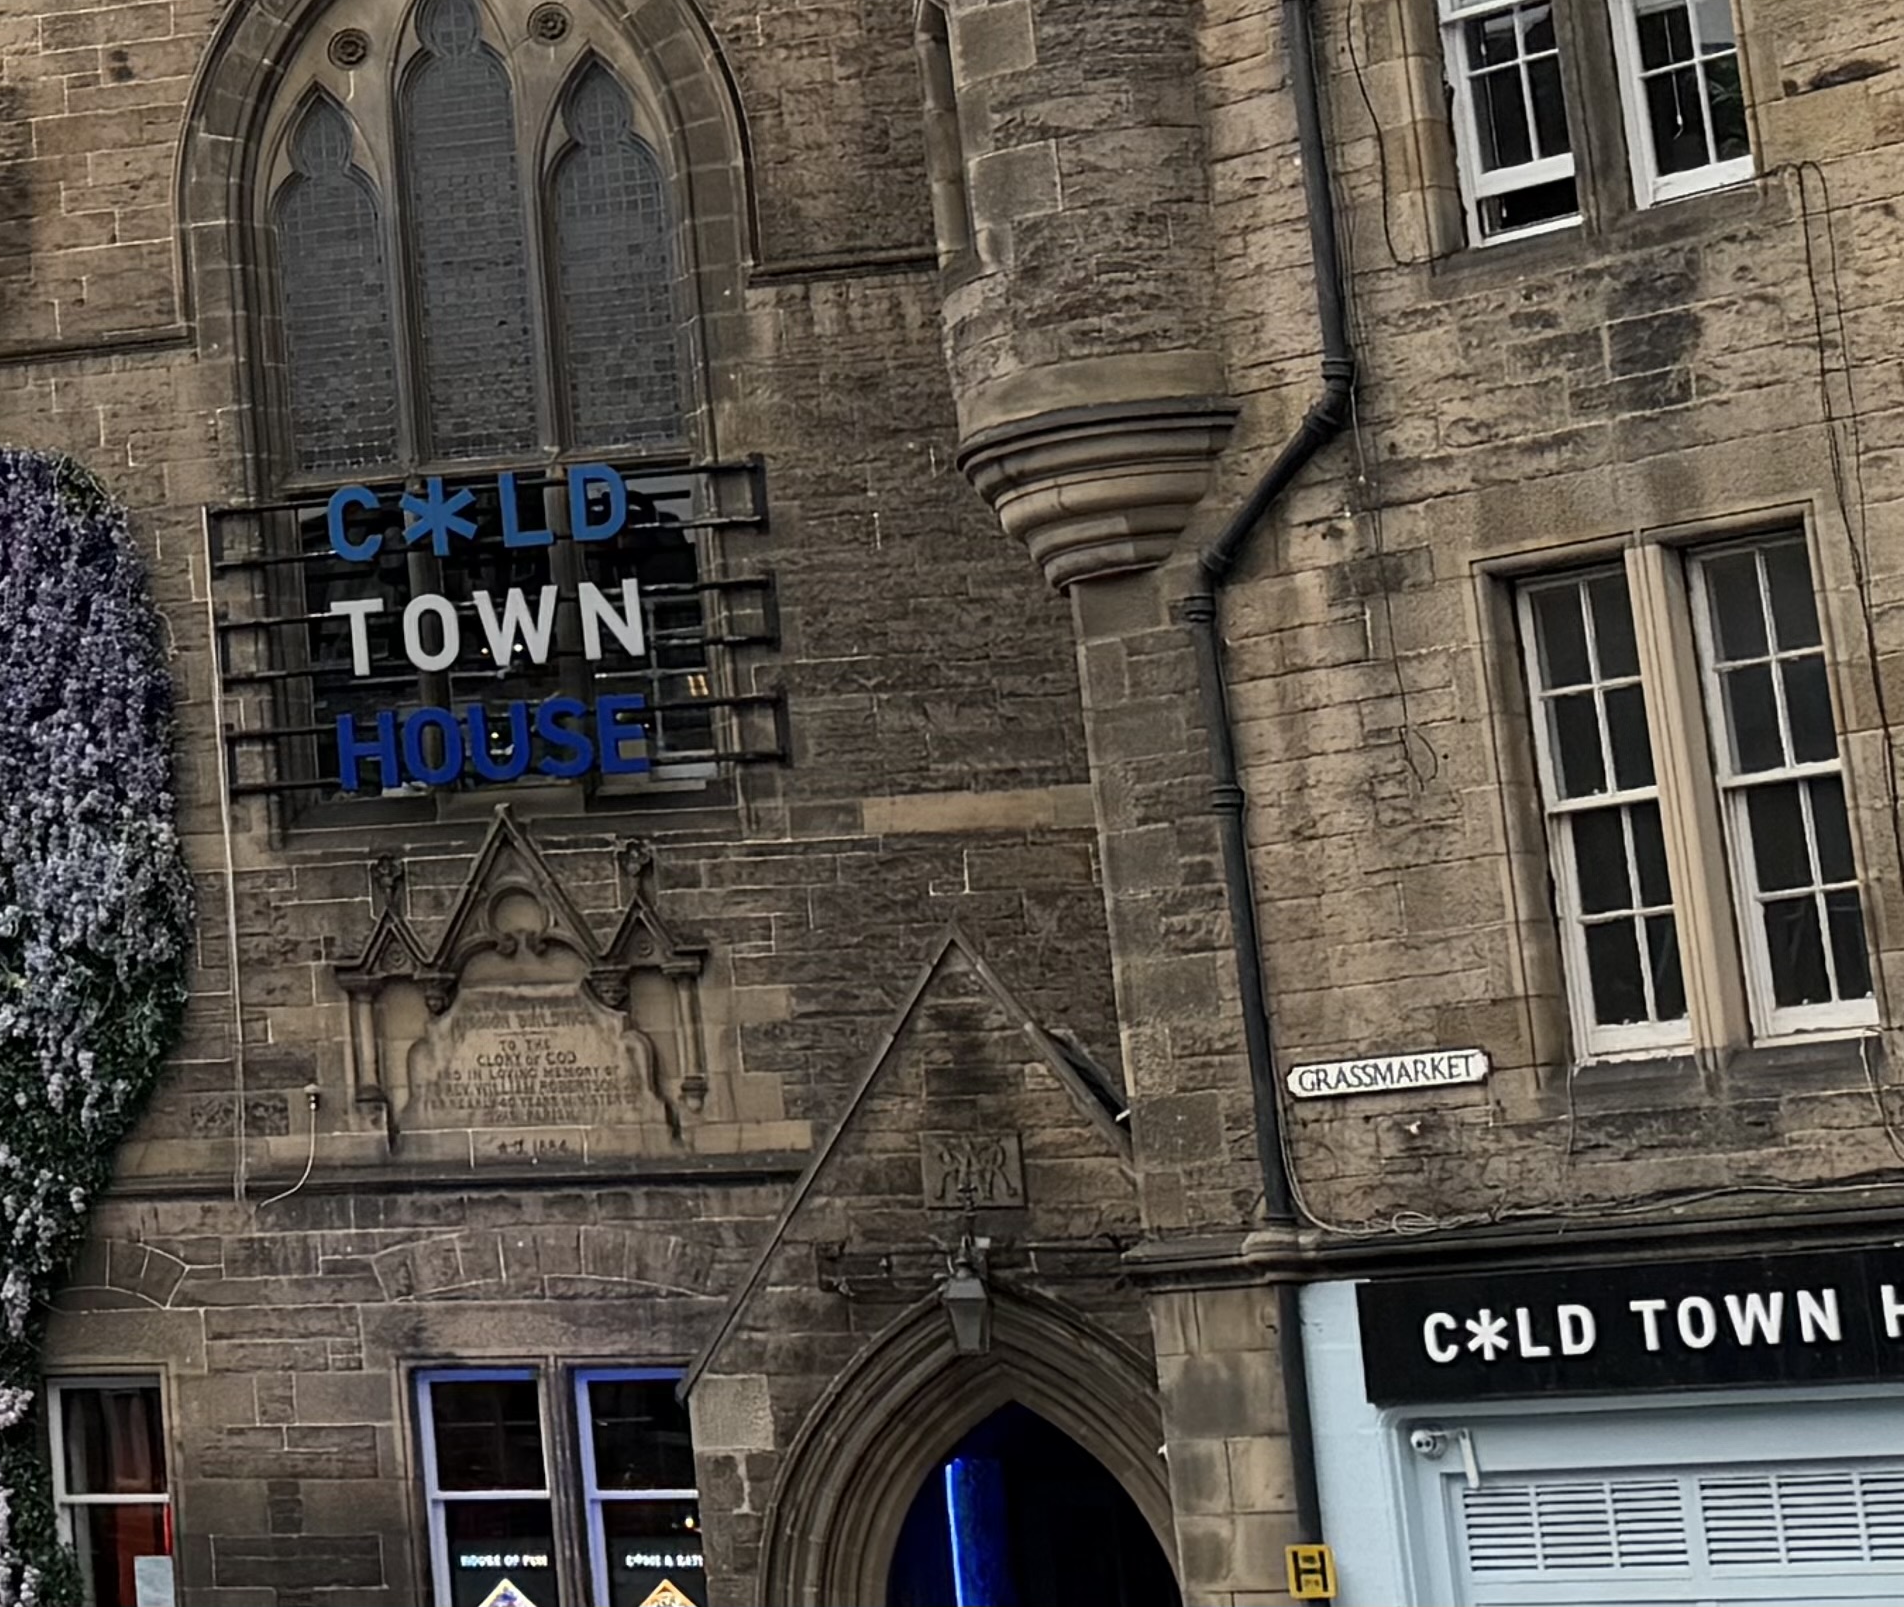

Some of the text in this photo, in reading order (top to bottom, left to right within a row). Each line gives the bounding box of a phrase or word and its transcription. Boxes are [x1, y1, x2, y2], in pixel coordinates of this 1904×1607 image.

[329, 578, 647, 677] TOWN
[335, 695, 651, 791] HOUSE
[1298, 1053, 1477, 1093] GRASSMARKET
[1629, 1288, 1843, 1352] TOWN
